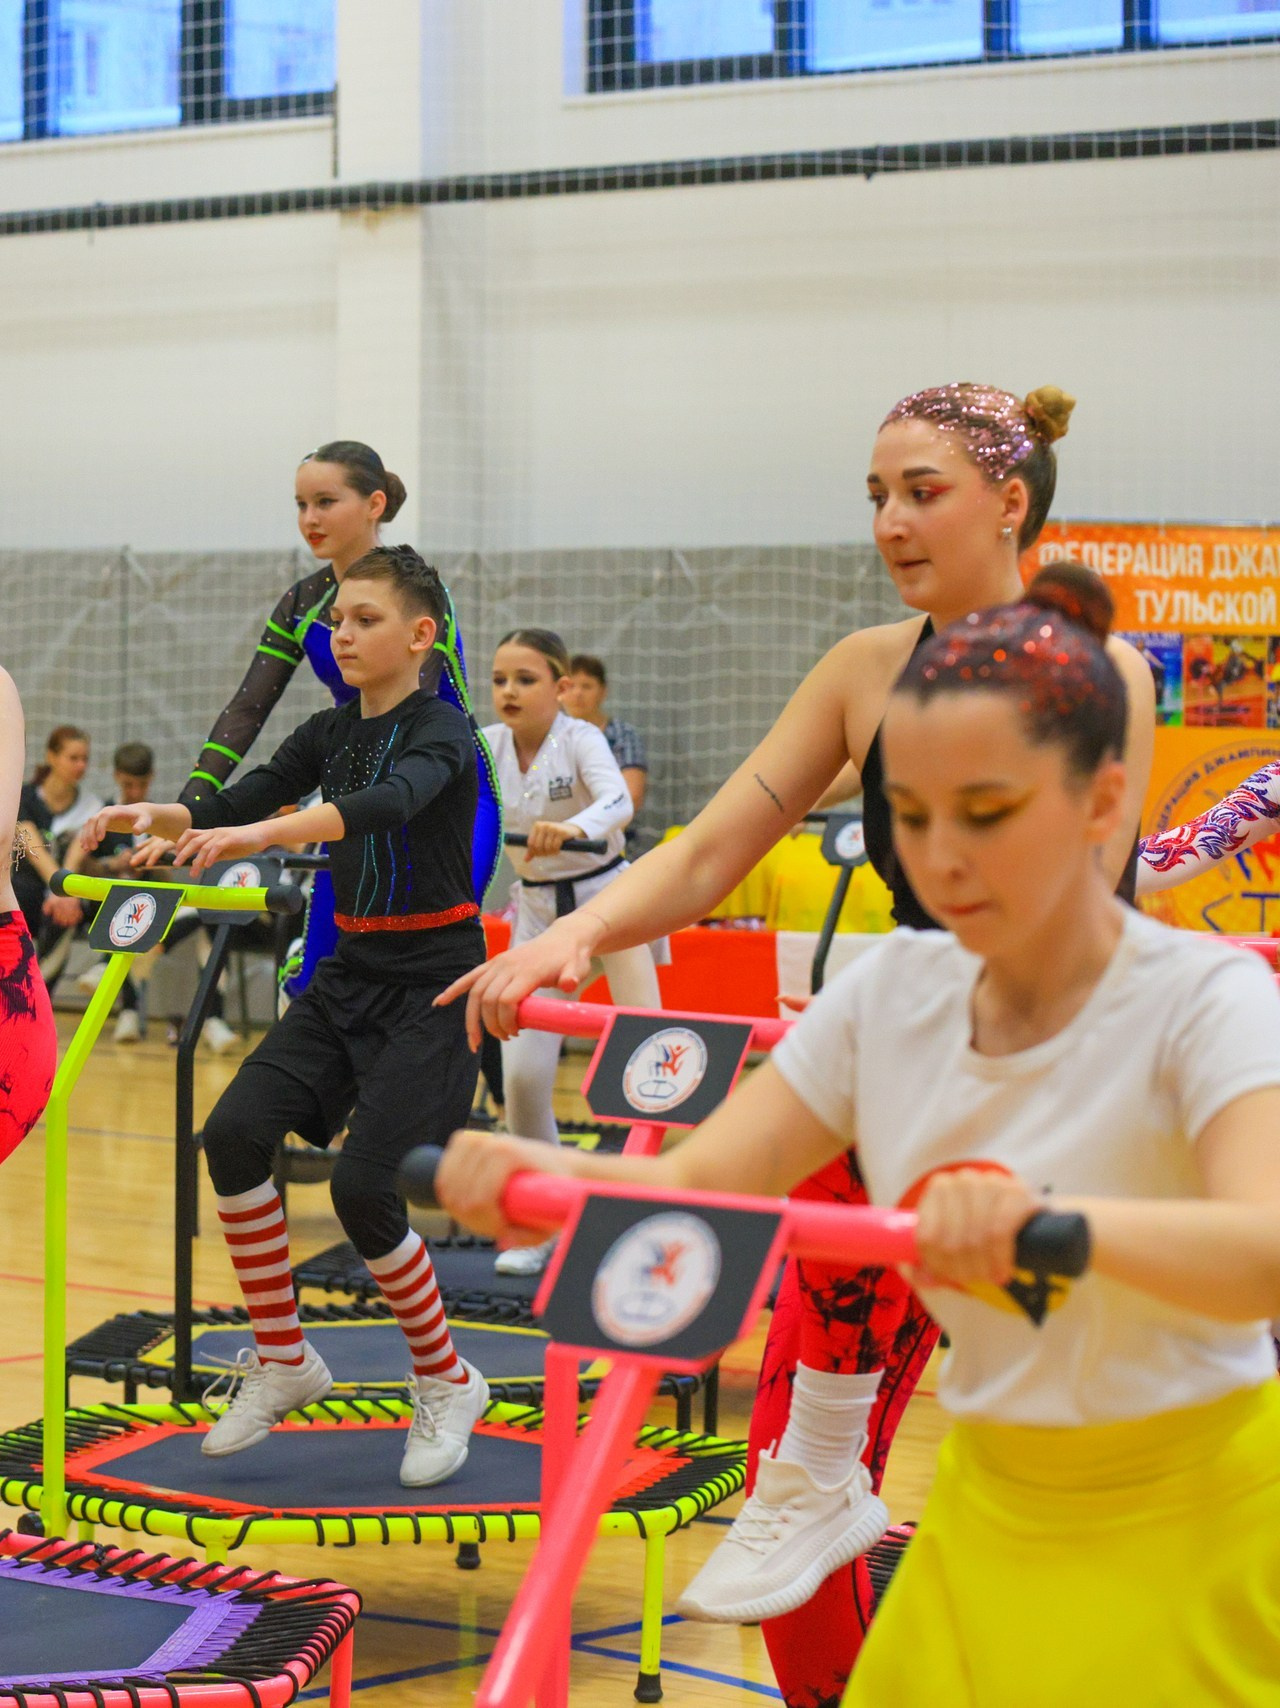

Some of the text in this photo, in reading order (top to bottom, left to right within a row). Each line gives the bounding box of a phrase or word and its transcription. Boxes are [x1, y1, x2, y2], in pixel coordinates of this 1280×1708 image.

[1039, 541, 1280, 581] ФЕДЕРАЦИЯ ДЖА
[1133, 586, 1277, 625] ТУЛЬСКОЙ
